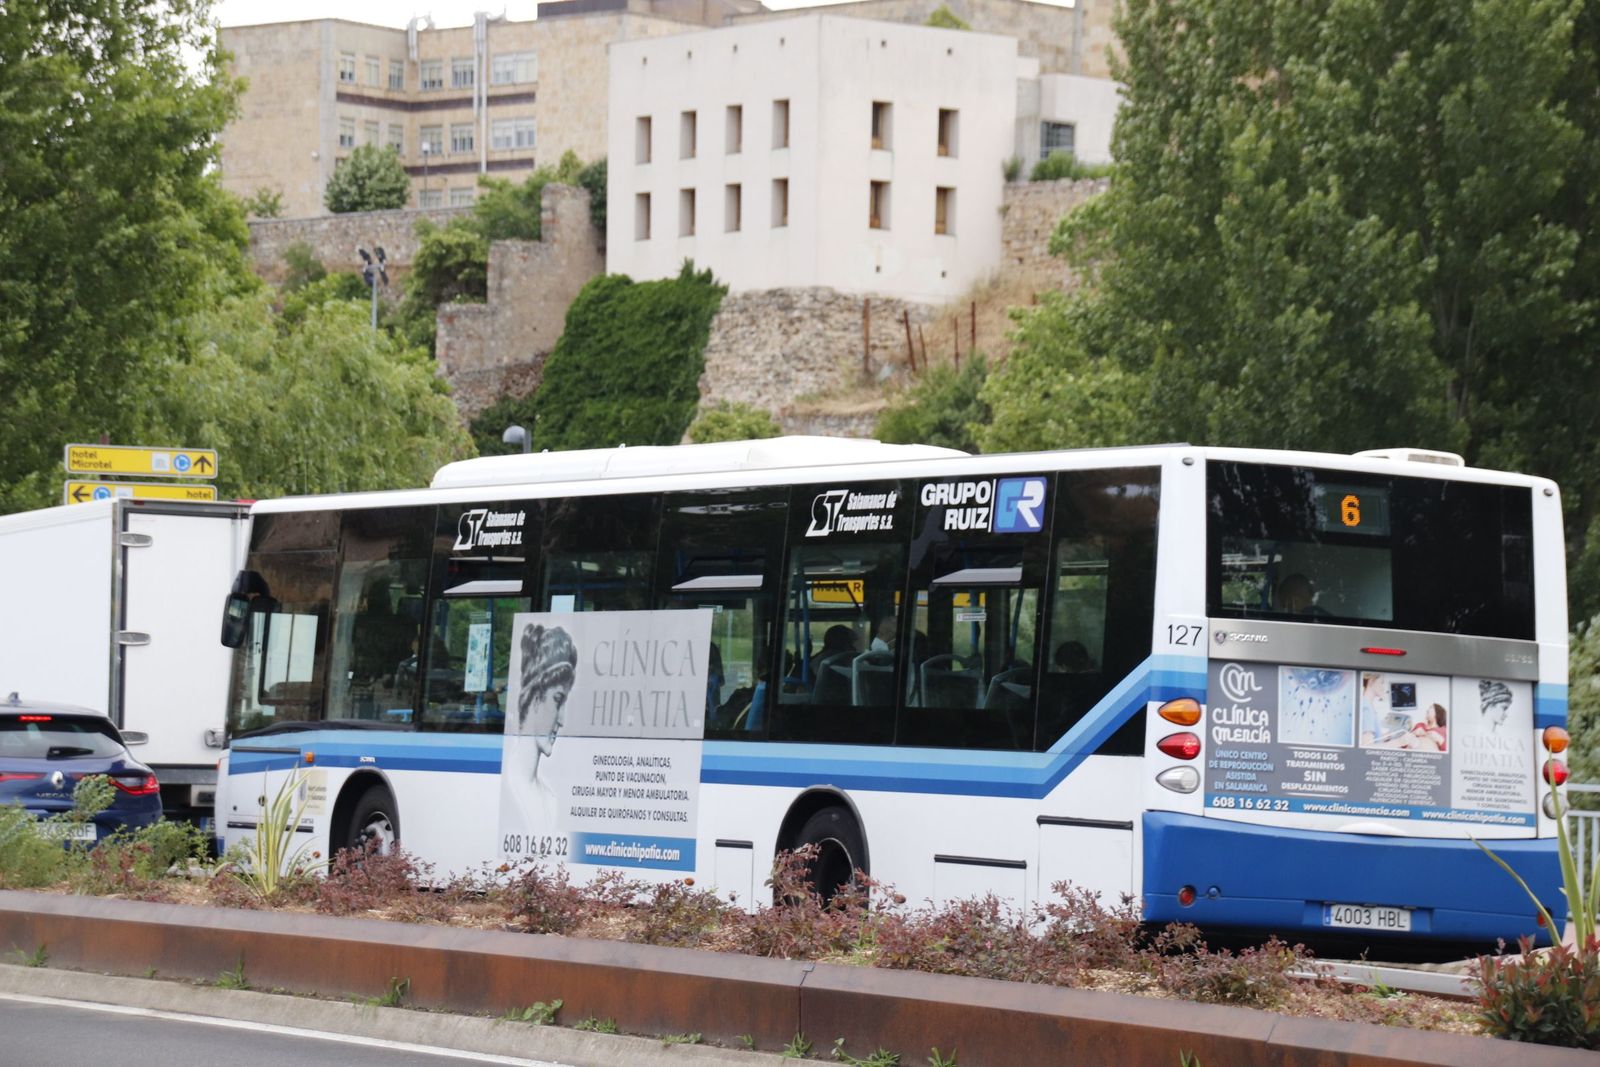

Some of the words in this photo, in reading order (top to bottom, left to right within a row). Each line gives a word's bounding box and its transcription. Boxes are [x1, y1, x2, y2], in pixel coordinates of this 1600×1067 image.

[72, 450, 97, 459] hotel
[72, 459, 112, 469] Microtel
[186, 490, 212, 499] hotel
[847, 492, 887, 510] Salamanca
[886, 490, 898, 508] de
[920, 480, 992, 507] GRUPO
[486, 511, 518, 528] Salamanca
[517, 509, 526, 526] de
[944, 507, 990, 530] RUIZ
[1341, 494, 1360, 527] 6
[837, 513, 880, 534] Transportes
[477, 529, 512, 548] Transportes
[1167, 624, 1203, 646] 127
[593, 628, 697, 677] CLÍNICA
[591, 690, 690, 728] HIPATIA
[1212, 704, 1270, 727] CLÍNICA
[1215, 747, 1239, 759] ÚNICO
[1240, 750, 1268, 760] CENTRO
[1293, 751, 1321, 760] TODOS
[1322, 752, 1338, 761] LOS
[1209, 760, 1218, 768] DE
[1286, 760, 1345, 771] TRATAMIENTOS
[595, 771, 616, 782] PUNTO
[617, 771, 625, 782] DE
[1225, 770, 1257, 780] ASISTIDA
[1304, 770, 1326, 782] SIN
[596, 786, 617, 798] MAYOR
[623, 788, 645, 799] MENOR
[1214, 781, 1224, 790] EN
[1225, 781, 1268, 792] SALAMANCA
[1281, 782, 1349, 793] DESPLAZAMIENTOS
[1212, 797, 1235, 808] 608
[1240, 797, 1253, 809] 16
[1256, 799, 1271, 810] 62
[1274, 800, 1289, 811] 32
[1302, 802, 1410, 817] www.clinicamencia.com
[570, 806, 598, 818] ALQUILER
[599, 807, 607, 818] DE
[653, 810, 689, 823] CONSULTAS.
[503, 834, 521, 853] 608
[525, 835, 536, 854] 16
[540, 837, 552, 856] 62
[555, 837, 568, 856] 32
[585, 841, 680, 863] www.clinicahipatia.com
[1334, 907, 1372, 925] 4003
[1377, 910, 1406, 928] HBL
